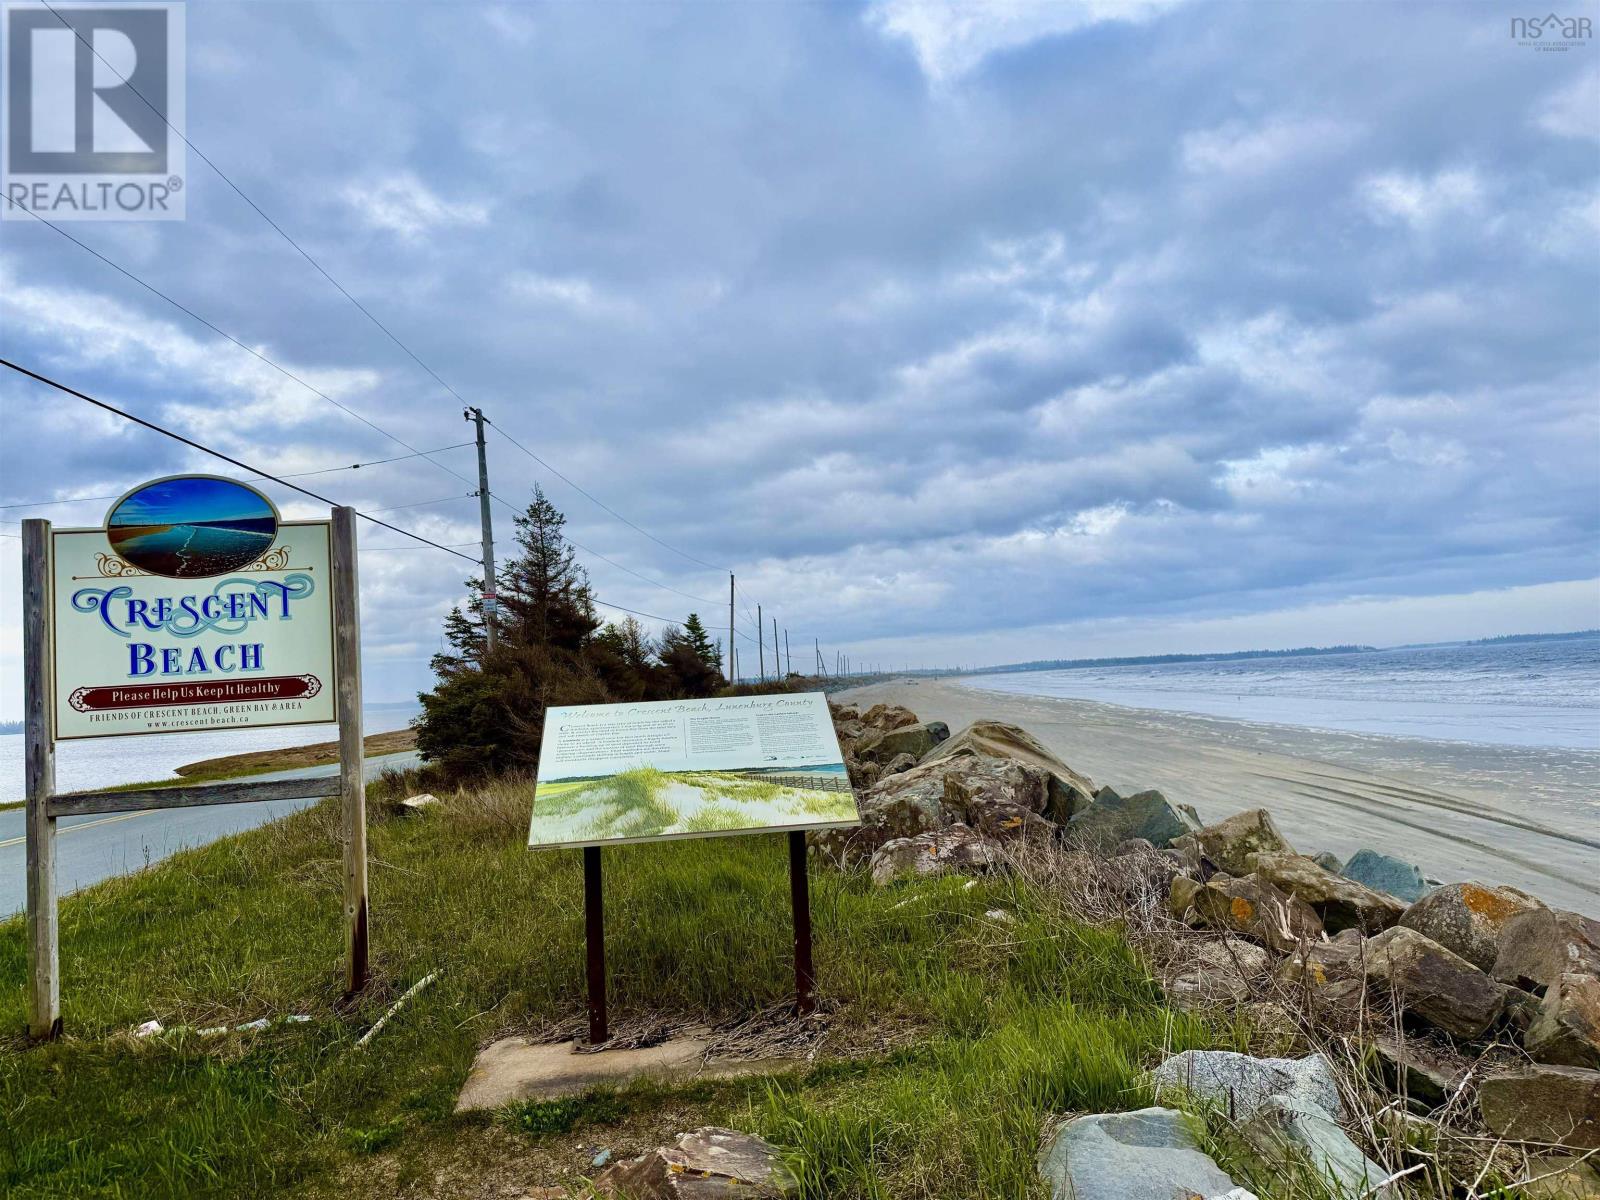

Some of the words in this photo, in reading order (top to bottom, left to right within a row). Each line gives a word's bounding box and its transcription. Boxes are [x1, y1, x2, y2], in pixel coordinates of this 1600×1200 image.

[71, 574, 314, 638] CRESCENT
[127, 643, 264, 678] BEACH
[112, 689, 150, 702] Please
[152, 687, 179, 701] Help
[180, 686, 194, 697] Us
[196, 685, 224, 699] Keep
[225, 684, 235, 694] It
[236, 682, 281, 695] Healthy
[89, 711, 129, 722] FRIENDS
[130, 711, 142, 720] OF
[144, 708, 188, 719] CRESCENT
[224, 704, 252, 714] GREEN
[253, 703, 269, 712] BAY
[271, 702, 278, 711] &
[279, 701, 302, 710] AREA
